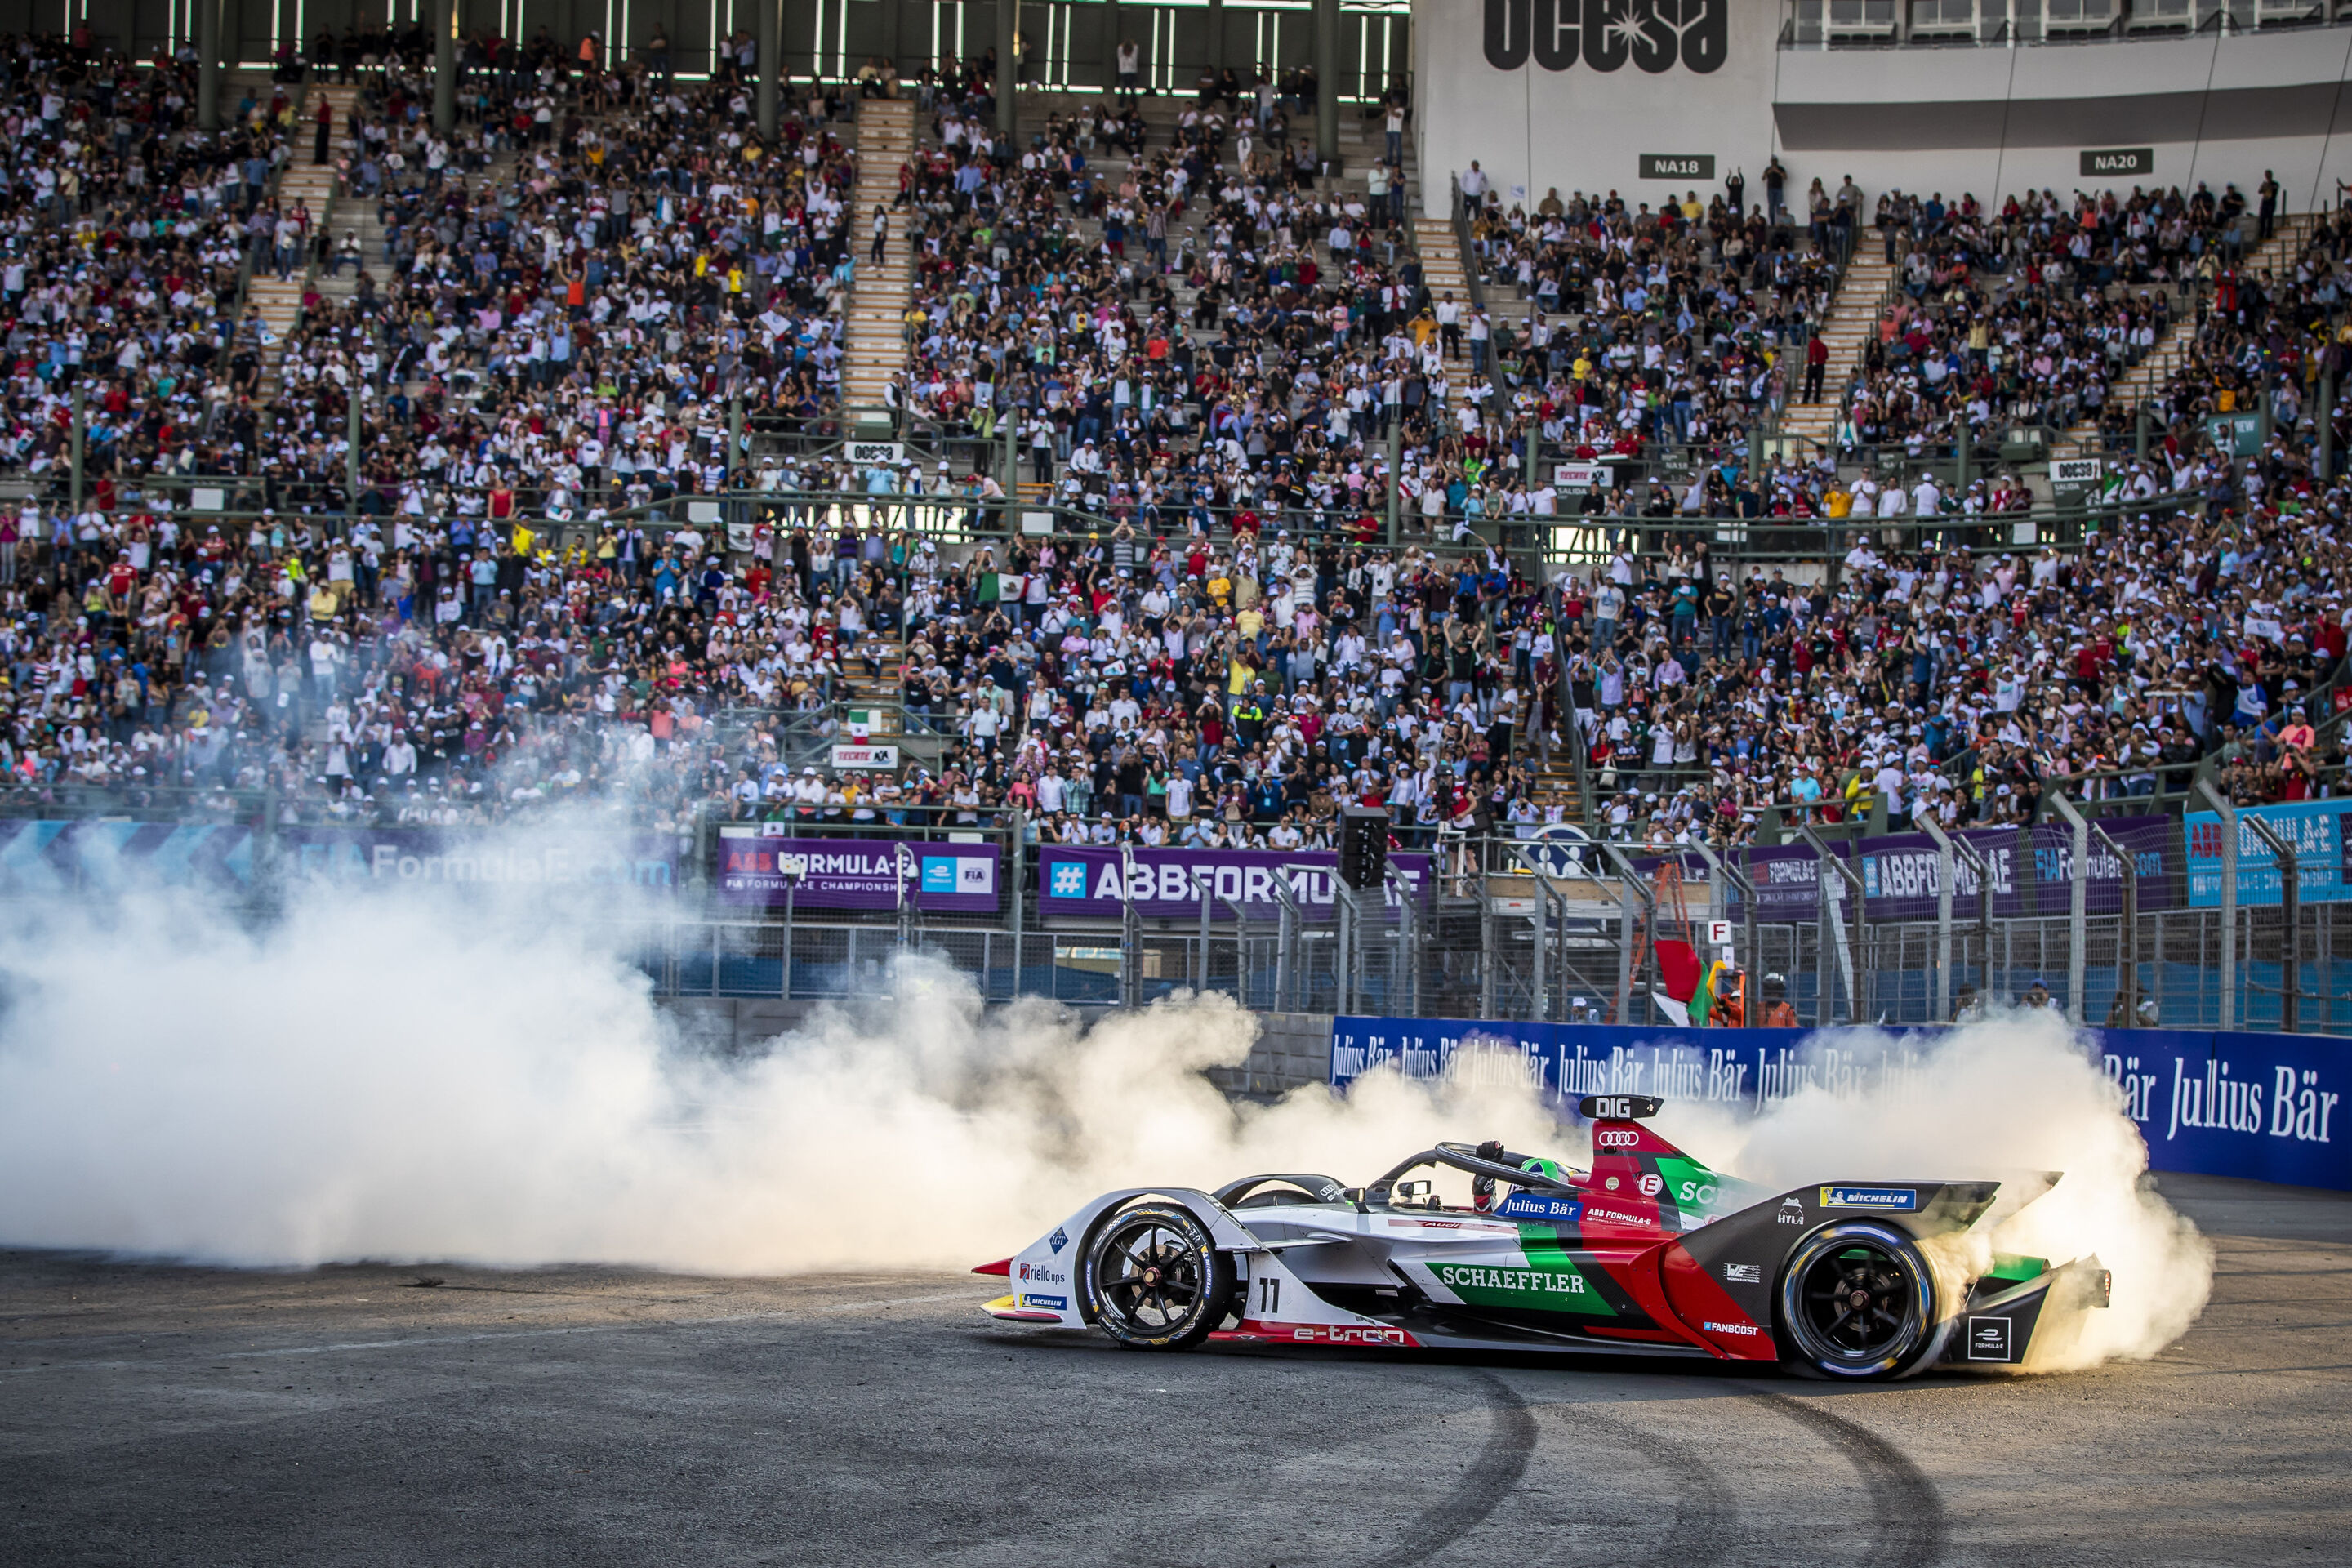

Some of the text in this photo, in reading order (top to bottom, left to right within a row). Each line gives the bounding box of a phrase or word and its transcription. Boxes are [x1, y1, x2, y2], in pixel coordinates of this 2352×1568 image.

[1655, 160, 1699, 174] NA18
[2095, 154, 2138, 170] NA20
[727, 852, 772, 871] ABB
[964, 871, 984, 880] FIA
[746, 880, 814, 890] FORMUA-E
[821, 881, 909, 893] CHAMPIONSHP
[1713, 924, 1726, 941] F
[1332, 1034, 1365, 1085] Julius
[1401, 1036, 1437, 1089] Julius
[1520, 1041, 1549, 1090] Bär
[1557, 1044, 1606, 1103] Julius
[1612, 1046, 1644, 1094] Bär
[1708, 1049, 1748, 1102] Bär
[1754, 1048, 1816, 1116] Julius
[1824, 1049, 1867, 1102] Bär
[2167, 1057, 2262, 1141] Julius
[2269, 1065, 2339, 1143] Bär
[1596, 1098, 1631, 1118] DIG
[1644, 1177, 1658, 1192] E
[1846, 1194, 1908, 1203] MICHELIN
[1505, 1199, 1576, 1215] Julius Bär
[1588, 1209, 1605, 1217] ABB
[1777, 1214, 1804, 1225] HYLA
[1051, 1236, 1065, 1245] LGT
[1031, 1264, 1065, 1285] riello ups
[1205, 1258, 1213, 1296] MICHELIN
[1442, 1267, 1585, 1294] SCHAEFFLER
[1032, 1298, 1062, 1307] MICHELIN
[1259, 1277, 1280, 1314] 11
[1294, 1325, 1405, 1343] e-tron
[1705, 1322, 1758, 1335] #FANBOOST
